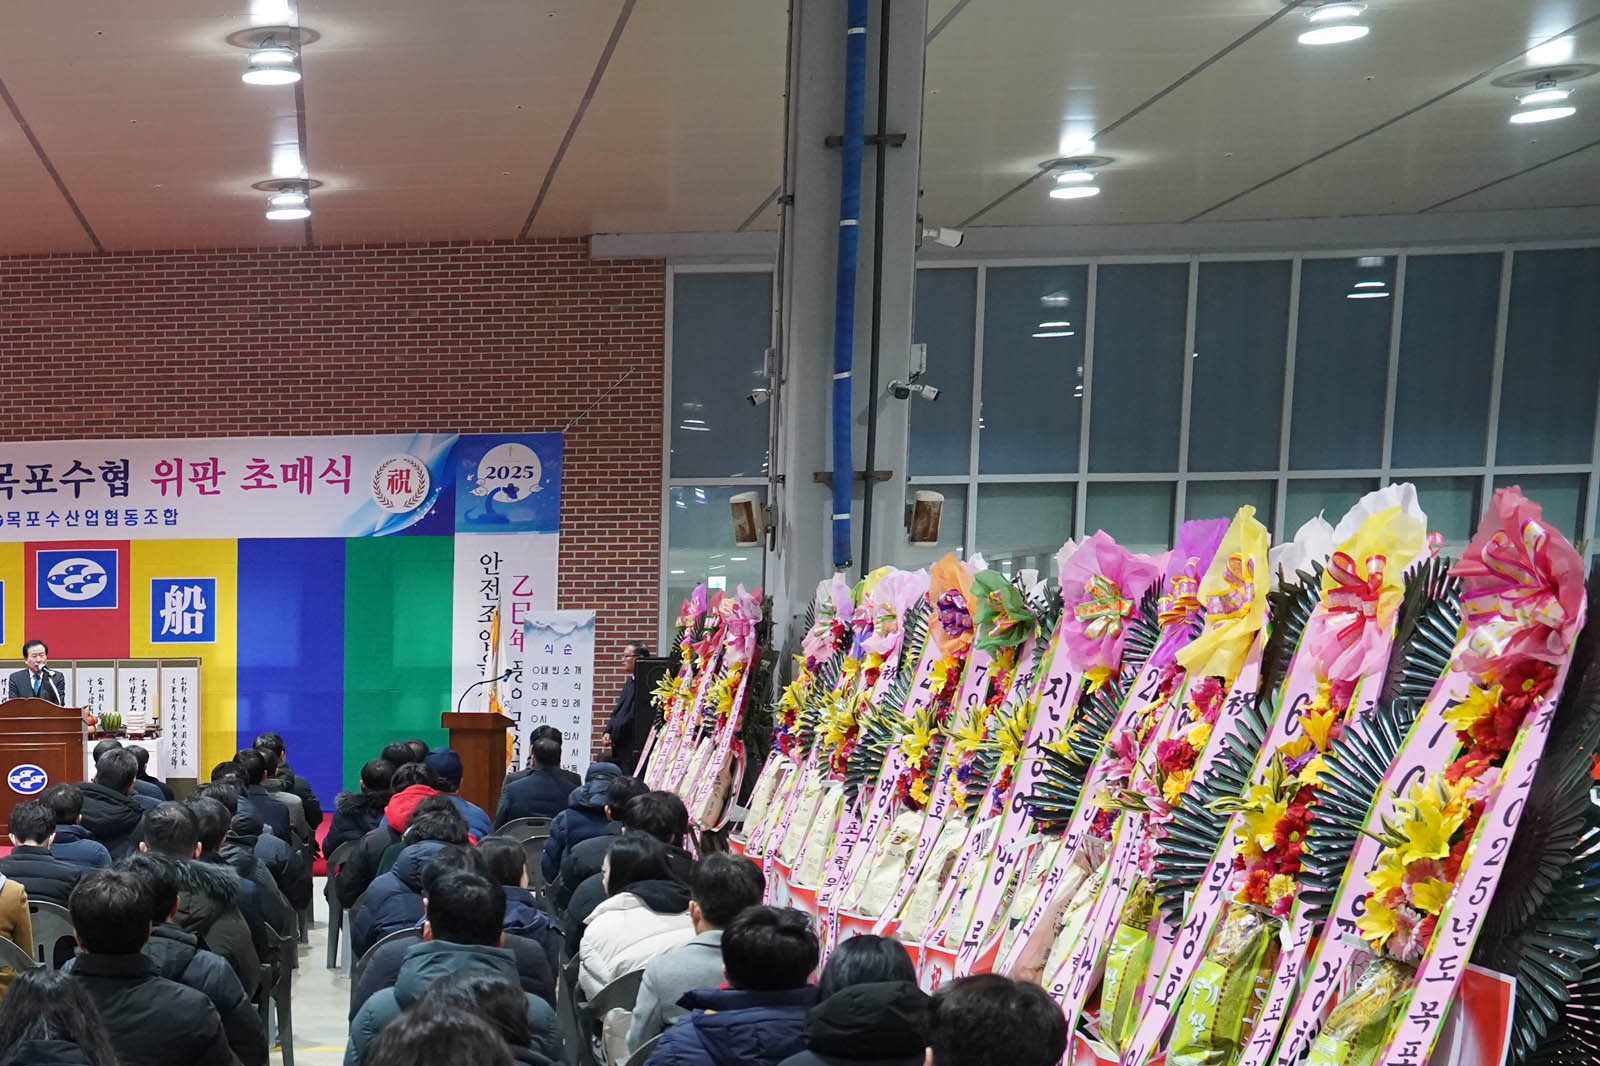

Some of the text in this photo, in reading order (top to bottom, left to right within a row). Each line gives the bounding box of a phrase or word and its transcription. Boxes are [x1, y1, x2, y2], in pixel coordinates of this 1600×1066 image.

[150, 457, 226, 497] 위판
[240, 454, 352, 496] 초매식
[387, 468, 412, 495] 祝
[484, 465, 534, 480] 2025
[6, 508, 179, 528] 목포수산업협동조합
[159, 585, 207, 635] 船
[1425, 758, 1541, 983] 2025년도
